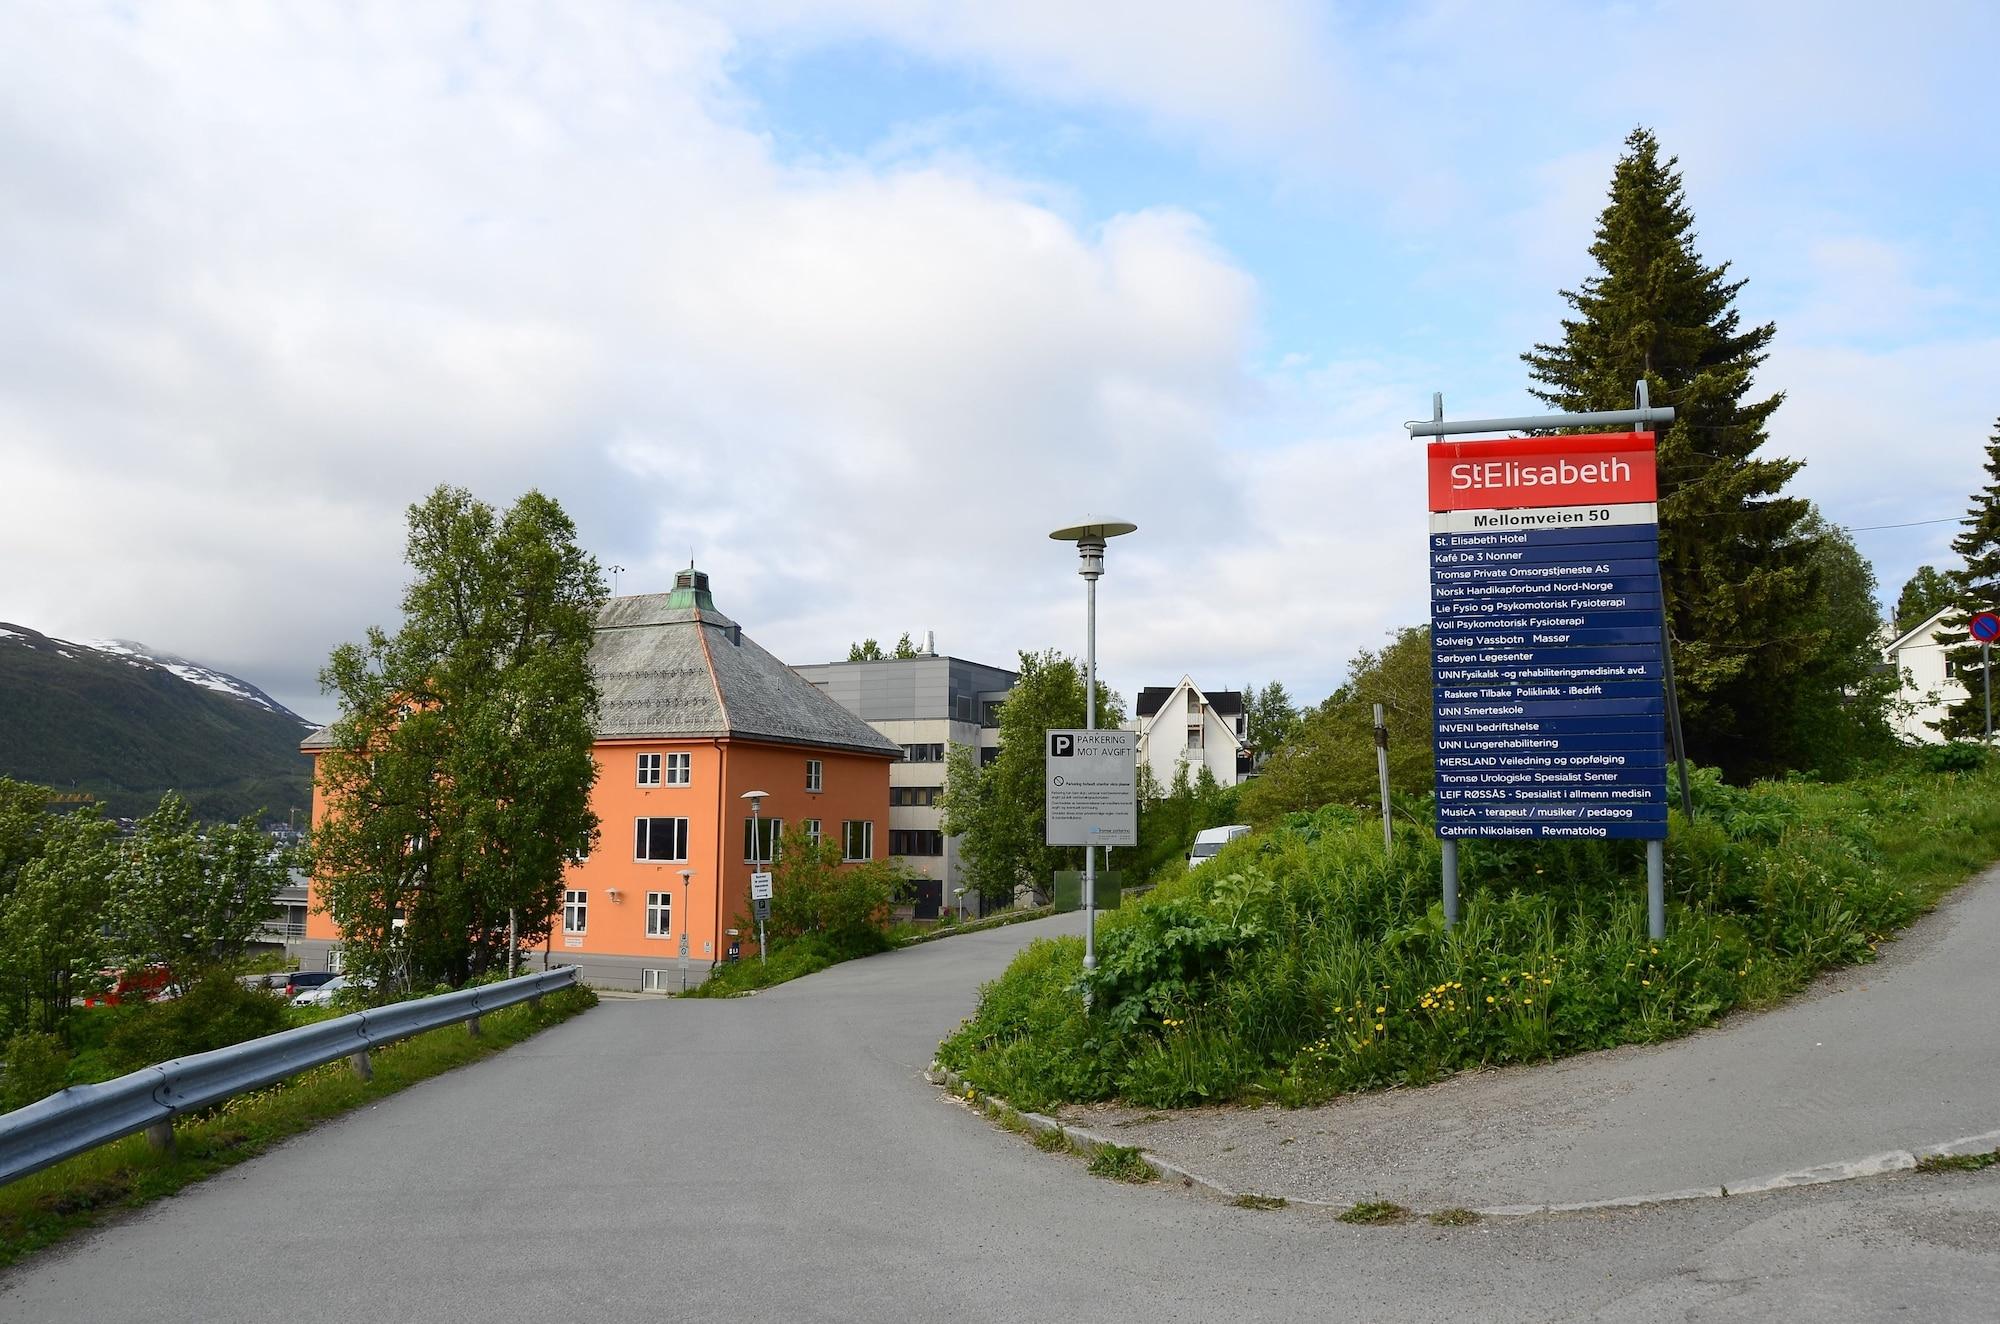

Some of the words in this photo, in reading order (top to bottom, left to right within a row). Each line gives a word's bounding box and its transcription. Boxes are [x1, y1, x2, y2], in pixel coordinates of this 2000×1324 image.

[1474, 512, 1583, 527] Mellomveien
[1588, 509, 1610, 521] 50
[1435, 537, 1448, 546] St.
[1451, 535, 1497, 546] Elisabeth
[1500, 534, 1527, 544] Hotel
[1435, 553, 1458, 563] Kafé
[1460, 553, 1474, 562] De
[1476, 552, 1483, 561] 3
[1486, 552, 1522, 560] Nonner
[1436, 571, 1471, 579] Tromsø
[1474, 569, 1507, 577] Private
[1509, 566, 1592, 577] Omsorgstjeneste
[1595, 564, 1610, 573] AS
[1436, 587, 1464, 596] Norsk
[1467, 583, 1551, 595] Handikapforbund
[1554, 582, 1613, 591] Nord-Norge
[1436, 604, 1450, 613] Lie
[1453, 603, 1478, 613] Fysio
[1481, 604, 1493, 612] og
[1496, 600, 1568, 611] Psykomotorisk
[1571, 598, 1625, 609] Fysioterapi
[1436, 621, 1454, 629] Voll
[1457, 618, 1527, 630] Psykomotorisk
[1530, 616, 1584, 627] Fysioterapi
[1436, 637, 1473, 646] Solveig
[1476, 635, 1524, 645] Vassbotn
[1533, 633, 1570, 643] Massør
[1437, 654, 1476, 663] Sørbyen
[1480, 652, 1533, 662] Legesenter
[1438, 671, 1460, 679] UNN
[1461, 669, 1499, 680] Fysikalsk
[1519, 666, 1625, 678] rehabiliteringsmedisinsk
[1627, 666, 1647, 674] avd.
[1444, 690, 1478, 698] Raskere
[1480, 689, 1511, 697] Tilbake
[1517, 687, 1560, 697] Poliklinikk
[1568, 685, 1602, 694] iBedrift
[1438, 707, 1461, 716] UNN
[1464, 706, 1523, 715] Smerteskole
[1439, 724, 1474, 732] INVENI
[1476, 722, 1539, 732] bedriftshelse
[1057, 736, 1070, 754] P
[1077, 735, 1126, 744] PARKERING
[1439, 741, 1461, 749] UNN
[1464, 739, 1558, 750] Lungerehabilitering
[1077, 748, 1098, 756] MOT
[1101, 748, 1131, 756] AVGIFT
[1440, 758, 1496, 766] MERSLAND
[1499, 756, 1551, 766] Veiledning
[1554, 757, 1567, 765] og
[1570, 755, 1625, 765] oppfølging
[1441, 774, 1478, 782] Tromsø
[1480, 773, 1531, 784] Urologiske
[1534, 772, 1581, 783] Spesialist
[1584, 772, 1618, 781] Senter
[1440, 790, 1461, 799] LEIF
[1464, 788, 1506, 799] RØSSÅS
[1515, 789, 1561, 799] Spesialist
[1564, 790, 1567, 798] i
[1569, 790, 1608, 798] allmenn
[1611, 789, 1651, 798] medisin
[1441, 808, 1476, 816] MusicA
[1485, 808, 1527, 817] terapeut
[1537, 808, 1576, 816] musiker
[1587, 808, 1632, 817] pedagog
[1440, 826, 1477, 835] Cathrin
[1480, 826, 1533, 835] Nikolaisen
[1542, 826, 1606, 836] Revmatolog
